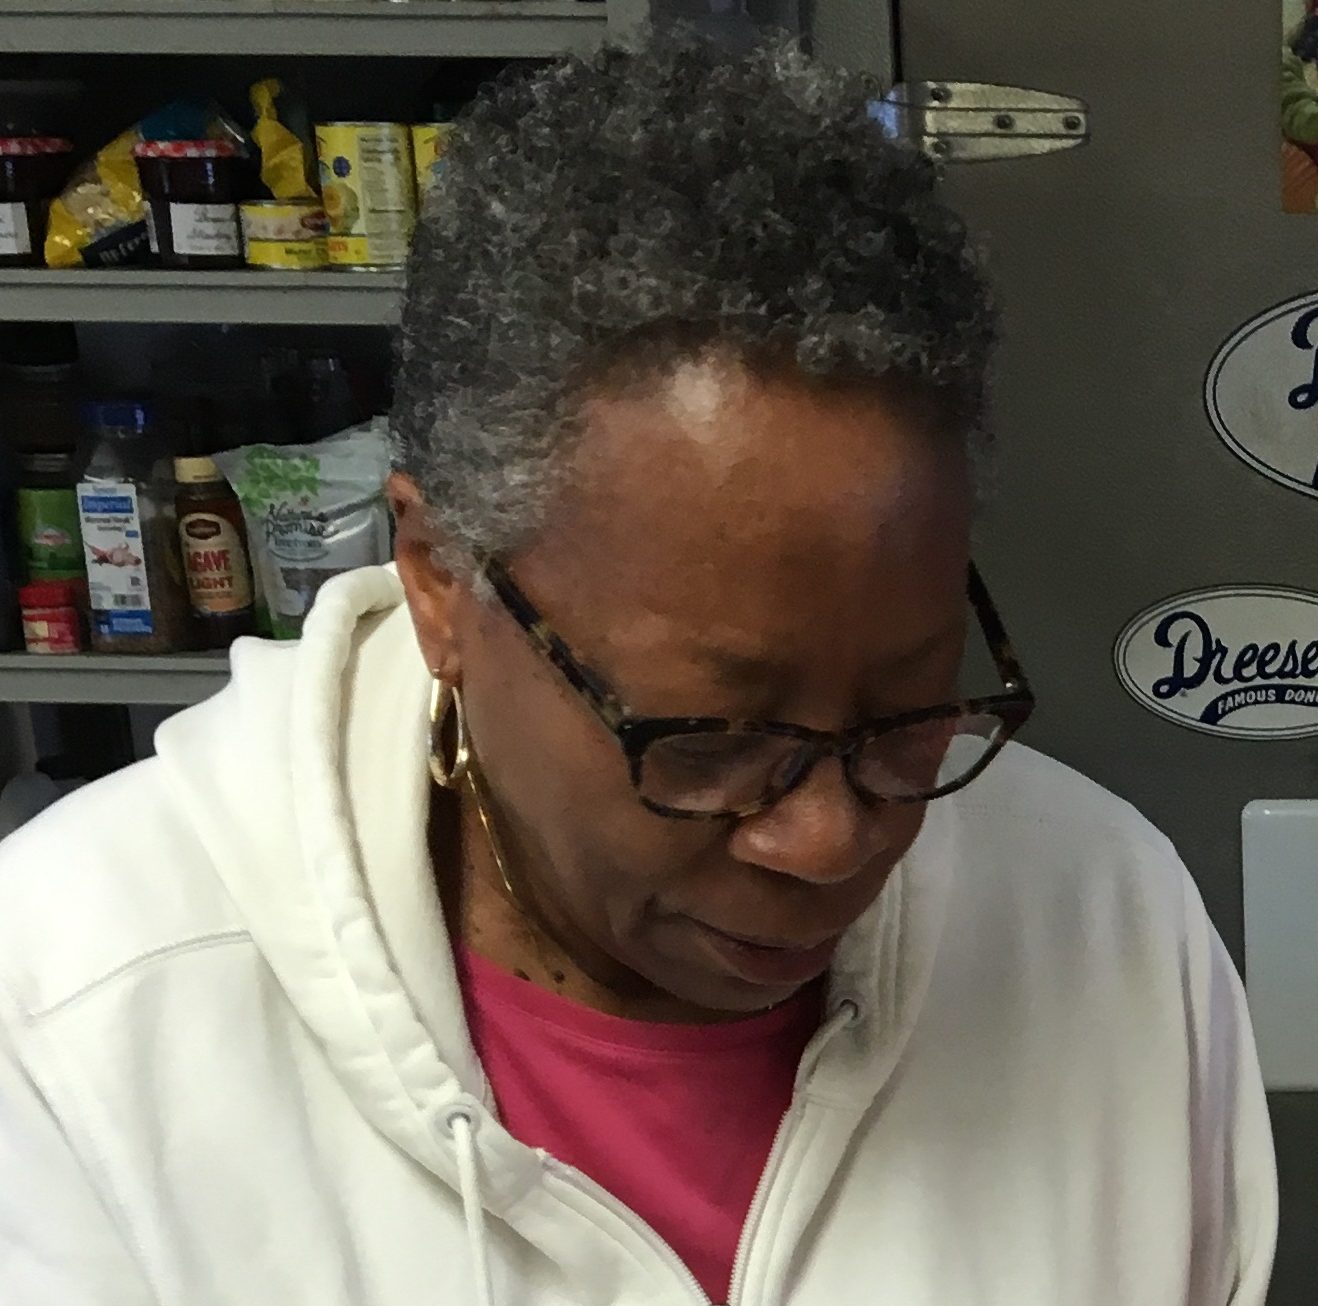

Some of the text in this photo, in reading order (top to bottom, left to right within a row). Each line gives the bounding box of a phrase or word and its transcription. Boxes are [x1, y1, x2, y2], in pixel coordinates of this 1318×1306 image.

[186, 549, 231, 572] AGAVE
[188, 576, 233, 589] LIGHT
[1217, 688, 1277, 715] FAMOUS
